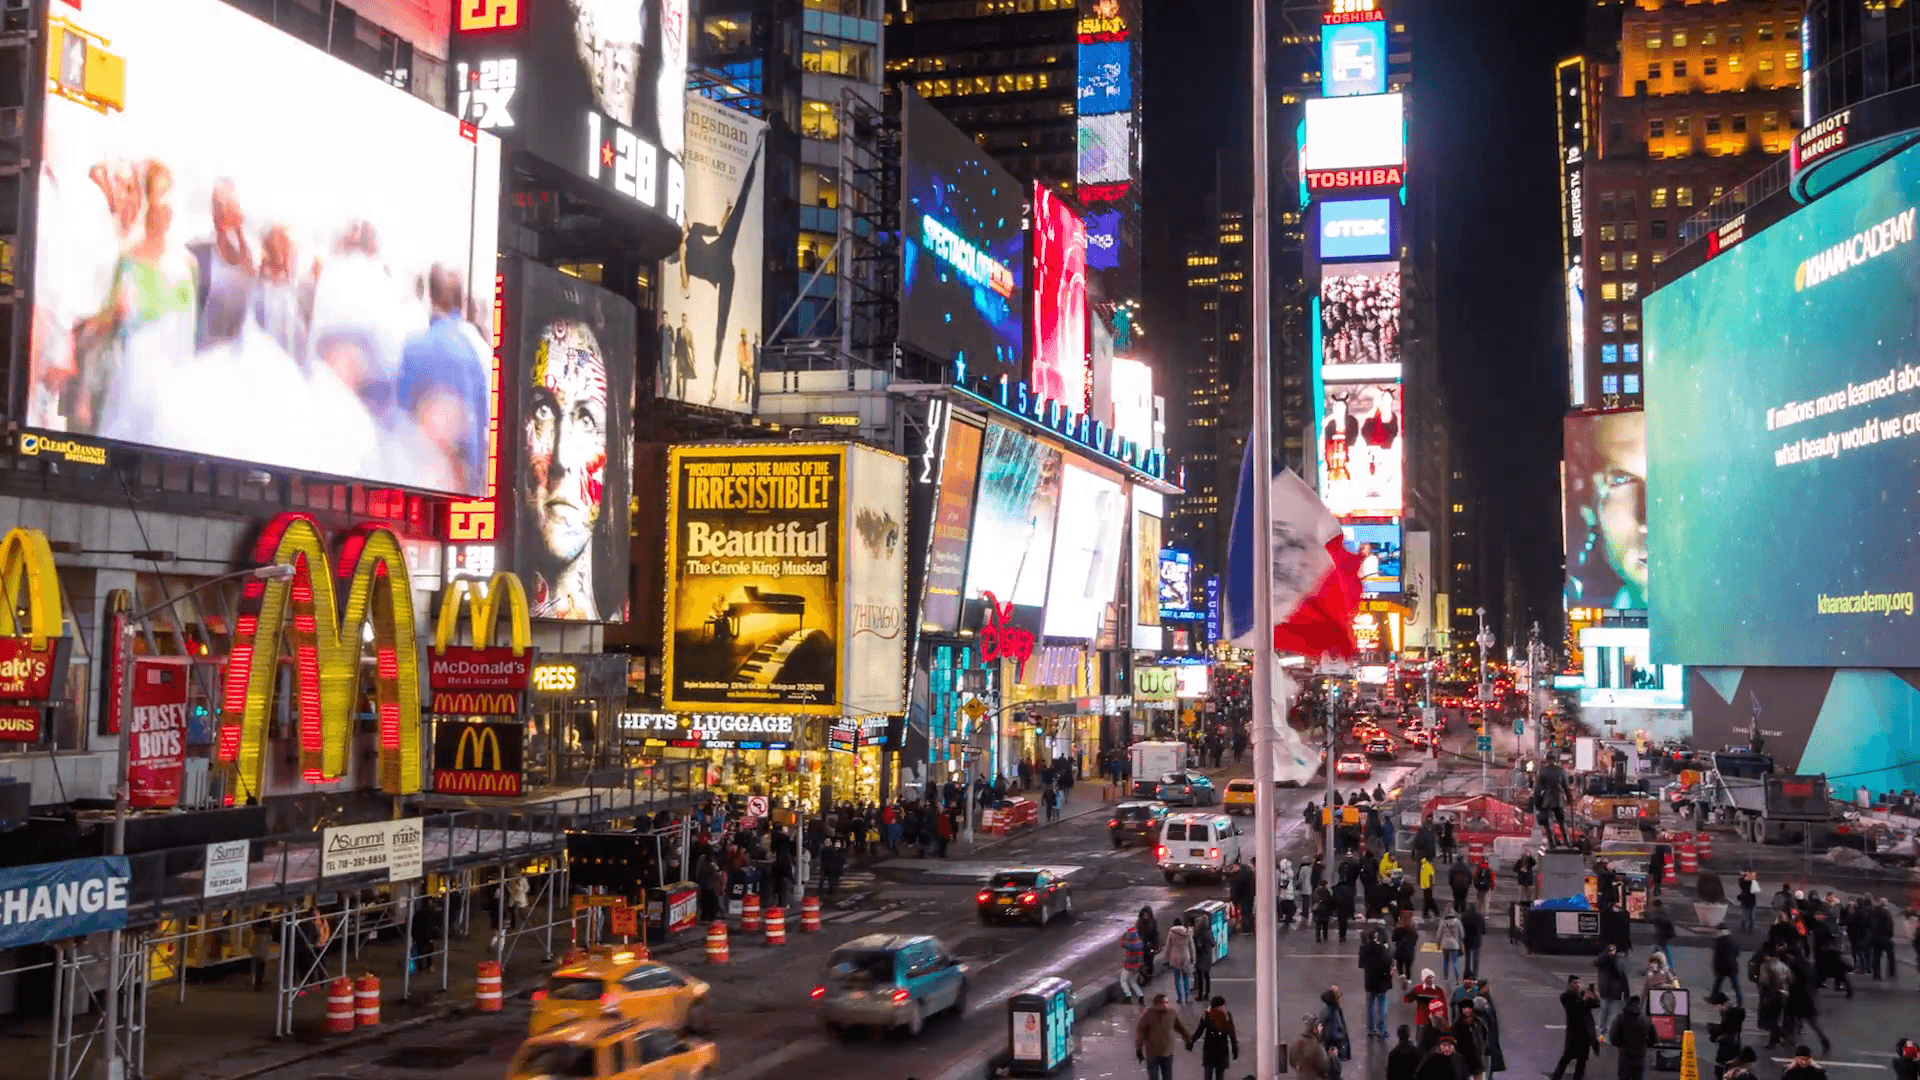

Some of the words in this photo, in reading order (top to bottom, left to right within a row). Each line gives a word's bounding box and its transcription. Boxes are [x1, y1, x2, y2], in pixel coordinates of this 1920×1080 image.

[1324, 10, 1383, 24] TOSHIBA
[1800, 110, 1850, 146] MARRIOTT
[1800, 130, 1843, 163] MARQUIS
[1308, 168, 1402, 189] TOSHIBA
[1571, 187, 1584, 237] REUTERS
[1718, 213, 1746, 238] MARRIOTT
[1719, 228, 1743, 250] MARQUIS
[1775, 401, 1815, 429] millions
[1816, 390, 1847, 417] more
[1848, 369, 1896, 407] learned
[1065, 405, 1166, 480] BROADWAY
[1774, 441, 1801, 467] what
[1801, 431, 1840, 459] beauty
[1841, 417, 1880, 450] would
[1879, 417, 1901, 441] we
[731, 462, 755, 477] JOINS
[756, 462, 771, 476] THE
[772, 462, 800, 476] RANKS
[801, 462, 813, 475] OF
[813, 461, 829, 475] THE
[687, 521, 828, 557] Beautiful
[687, 560, 710, 576] The
[710, 560, 750, 576] Carole
[752, 560, 780, 578] King
[781, 559, 827, 576] Musical
[1817, 590, 1914, 617] khanacademy.org
[0, 658, 46, 677] ald's
[433, 661, 526, 675] McDonald's
[448, 676, 508, 685] Restaurant
[131, 703, 187, 733] JERSEY
[617, 713, 677, 730] GIFTS
[692, 714, 792, 732] LUGGAGE
[139, 730, 181, 758] BOYS
[706, 740, 735, 748] SONY
[1617, 806, 1638, 819] CAT
[339, 831, 385, 849] Summit
[0, 877, 129, 925] HANGE
